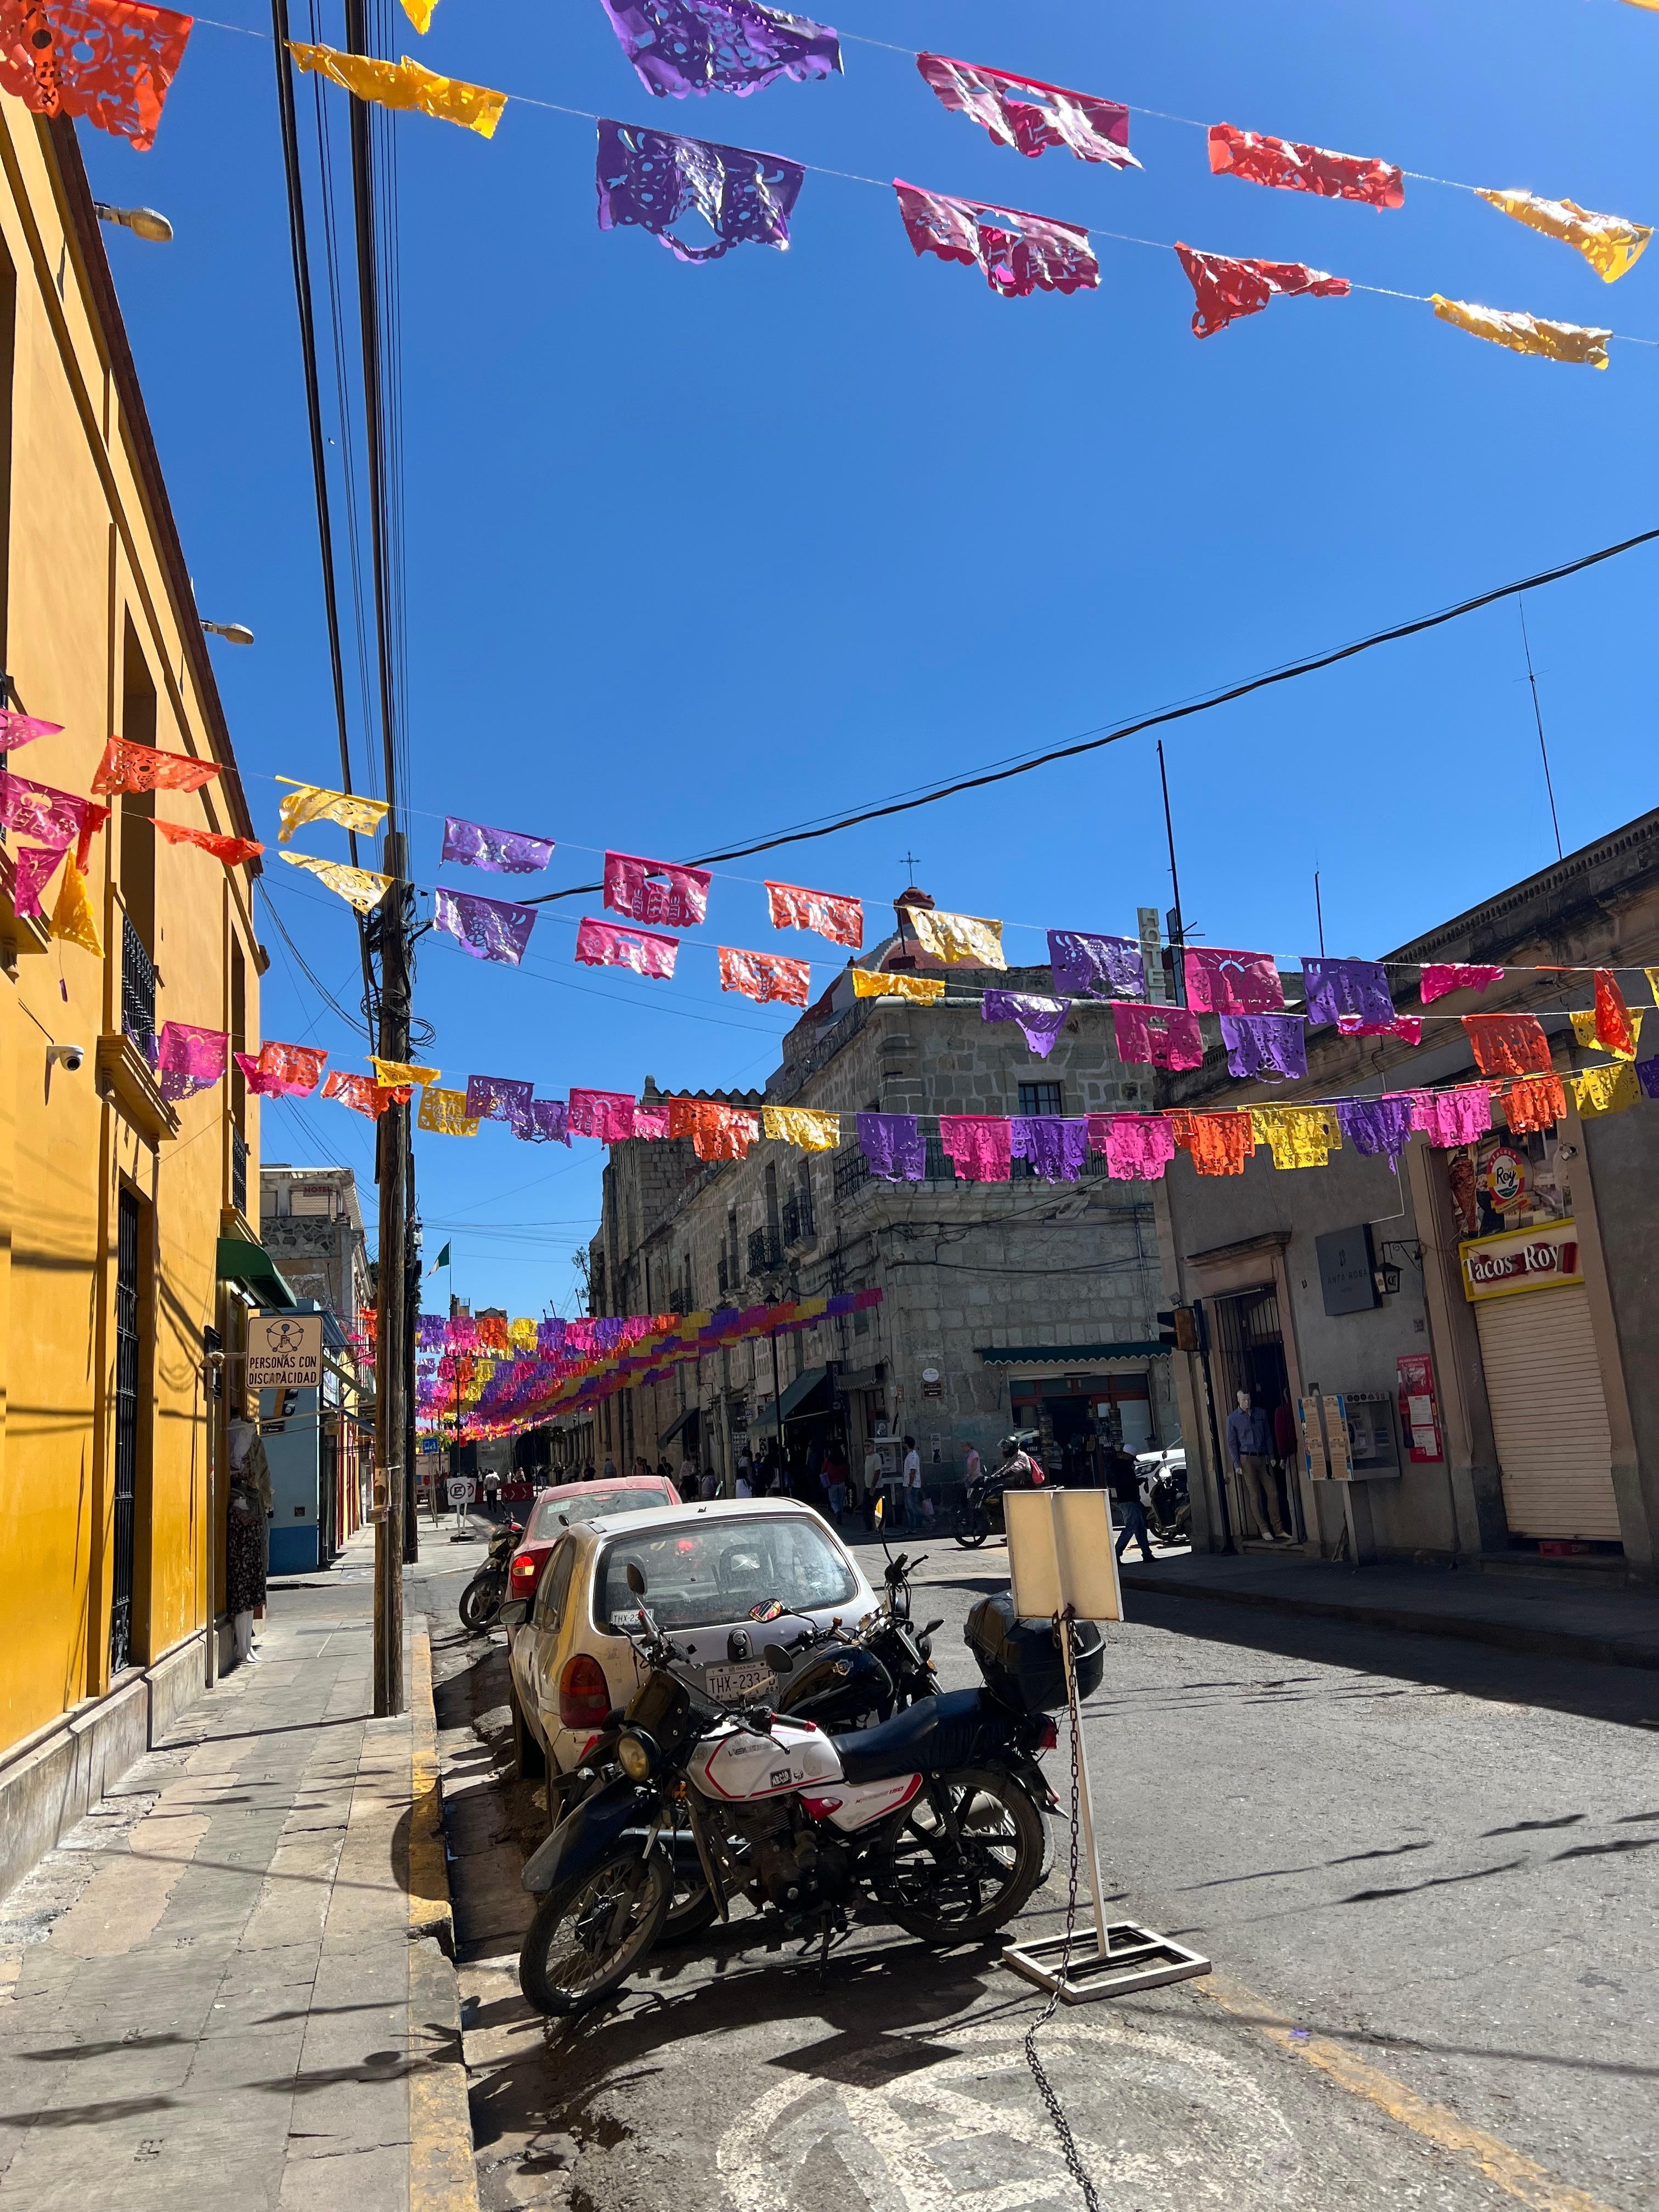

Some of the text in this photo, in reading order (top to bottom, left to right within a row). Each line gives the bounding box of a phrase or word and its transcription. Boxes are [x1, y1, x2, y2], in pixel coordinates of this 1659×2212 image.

[1497, 1166, 1516, 1187] Roy
[1463, 1244, 1560, 1282] Tacos Roy
[250, 1356, 317, 1369] PERSONAS CON
[249, 1372, 317, 1385] DISCAPACIDAD
[888, 1786, 904, 1795] 150
